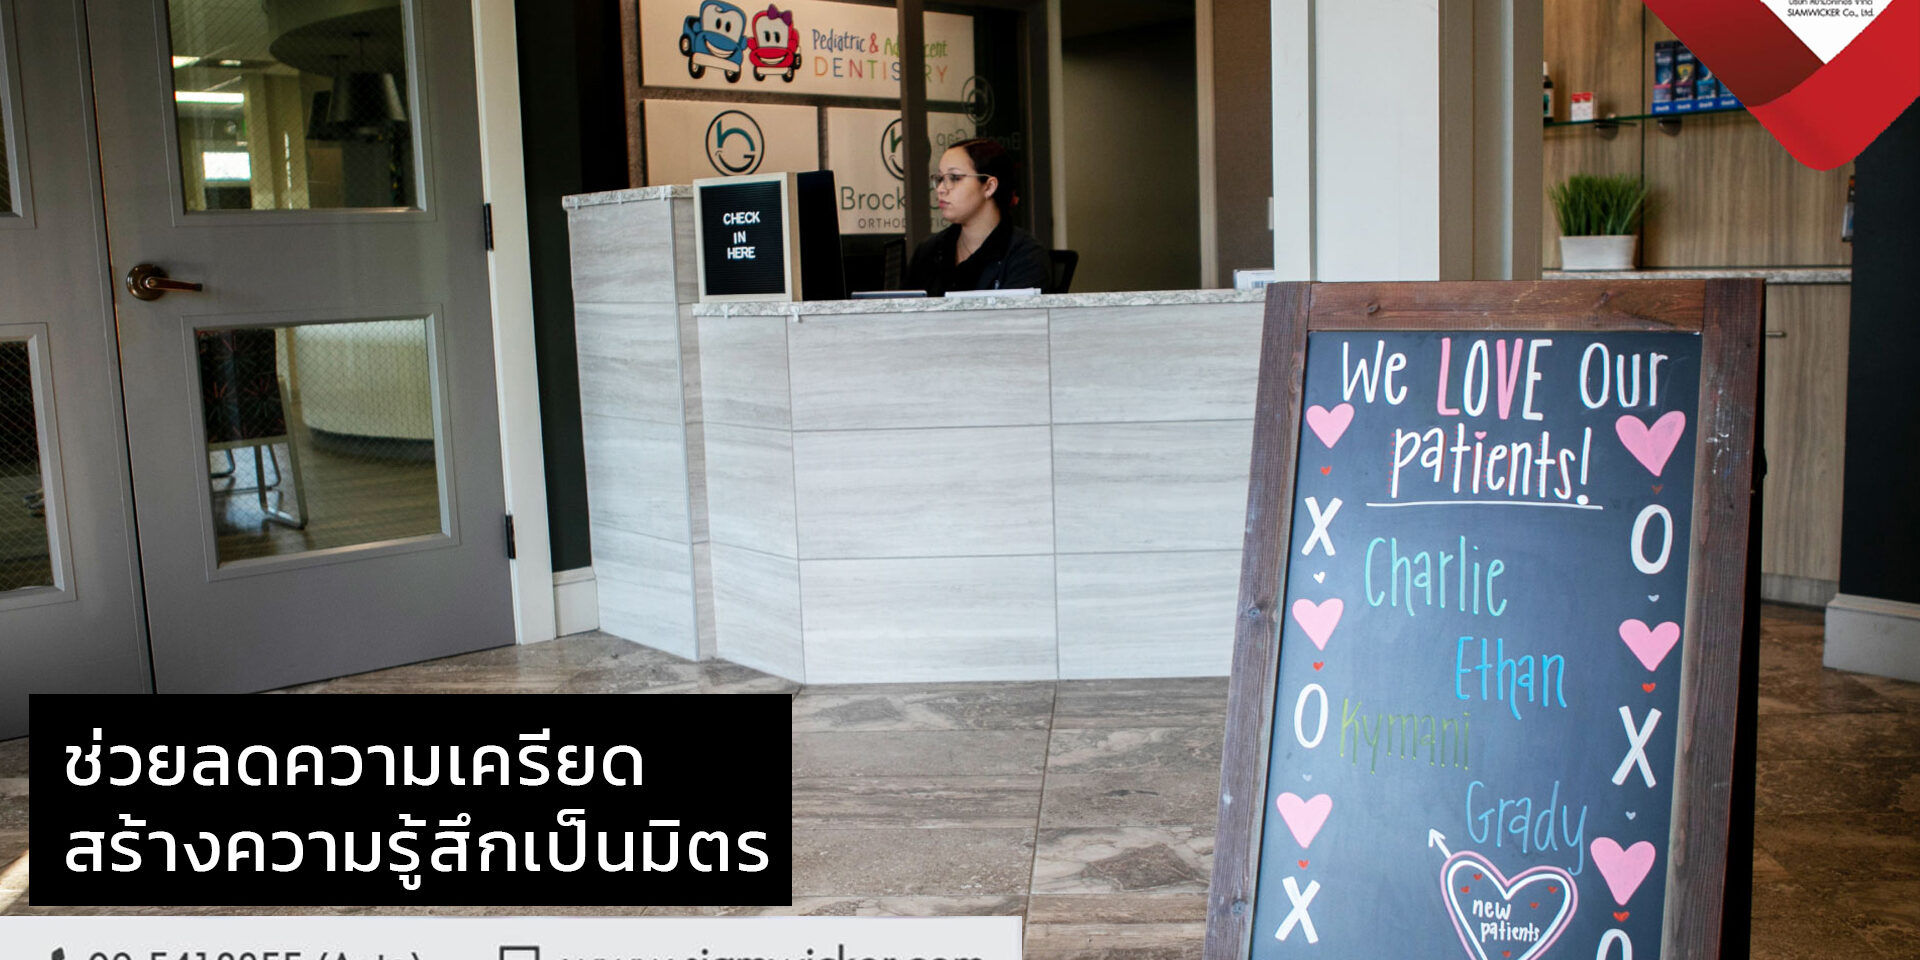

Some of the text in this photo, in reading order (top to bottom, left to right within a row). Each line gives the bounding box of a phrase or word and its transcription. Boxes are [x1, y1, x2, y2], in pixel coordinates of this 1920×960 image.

[812, 28, 866, 53] Pediatric
[869, 32, 879, 54] &
[814, 56, 948, 83] DENTISRY
[722, 211, 761, 226] CHECK
[733, 230, 747, 245] IN
[727, 246, 756, 260] HERE
[1342, 338, 1668, 421] We LOVE Our
[1389, 422, 1592, 506] patients!
[1301, 497, 1343, 557] X
[1630, 504, 1673, 575] O
[1365, 536, 1507, 616] Charlie
[1455, 636, 1567, 720] Ethan
[1294, 683, 1329, 749] O
[1339, 698, 1470, 775] Kymani
[1611, 705, 1662, 788] X
[1465, 781, 1588, 876] Grady
[1274, 876, 1321, 944] X
[1472, 900, 1512, 921] new
[1480, 920, 1541, 943] patients
